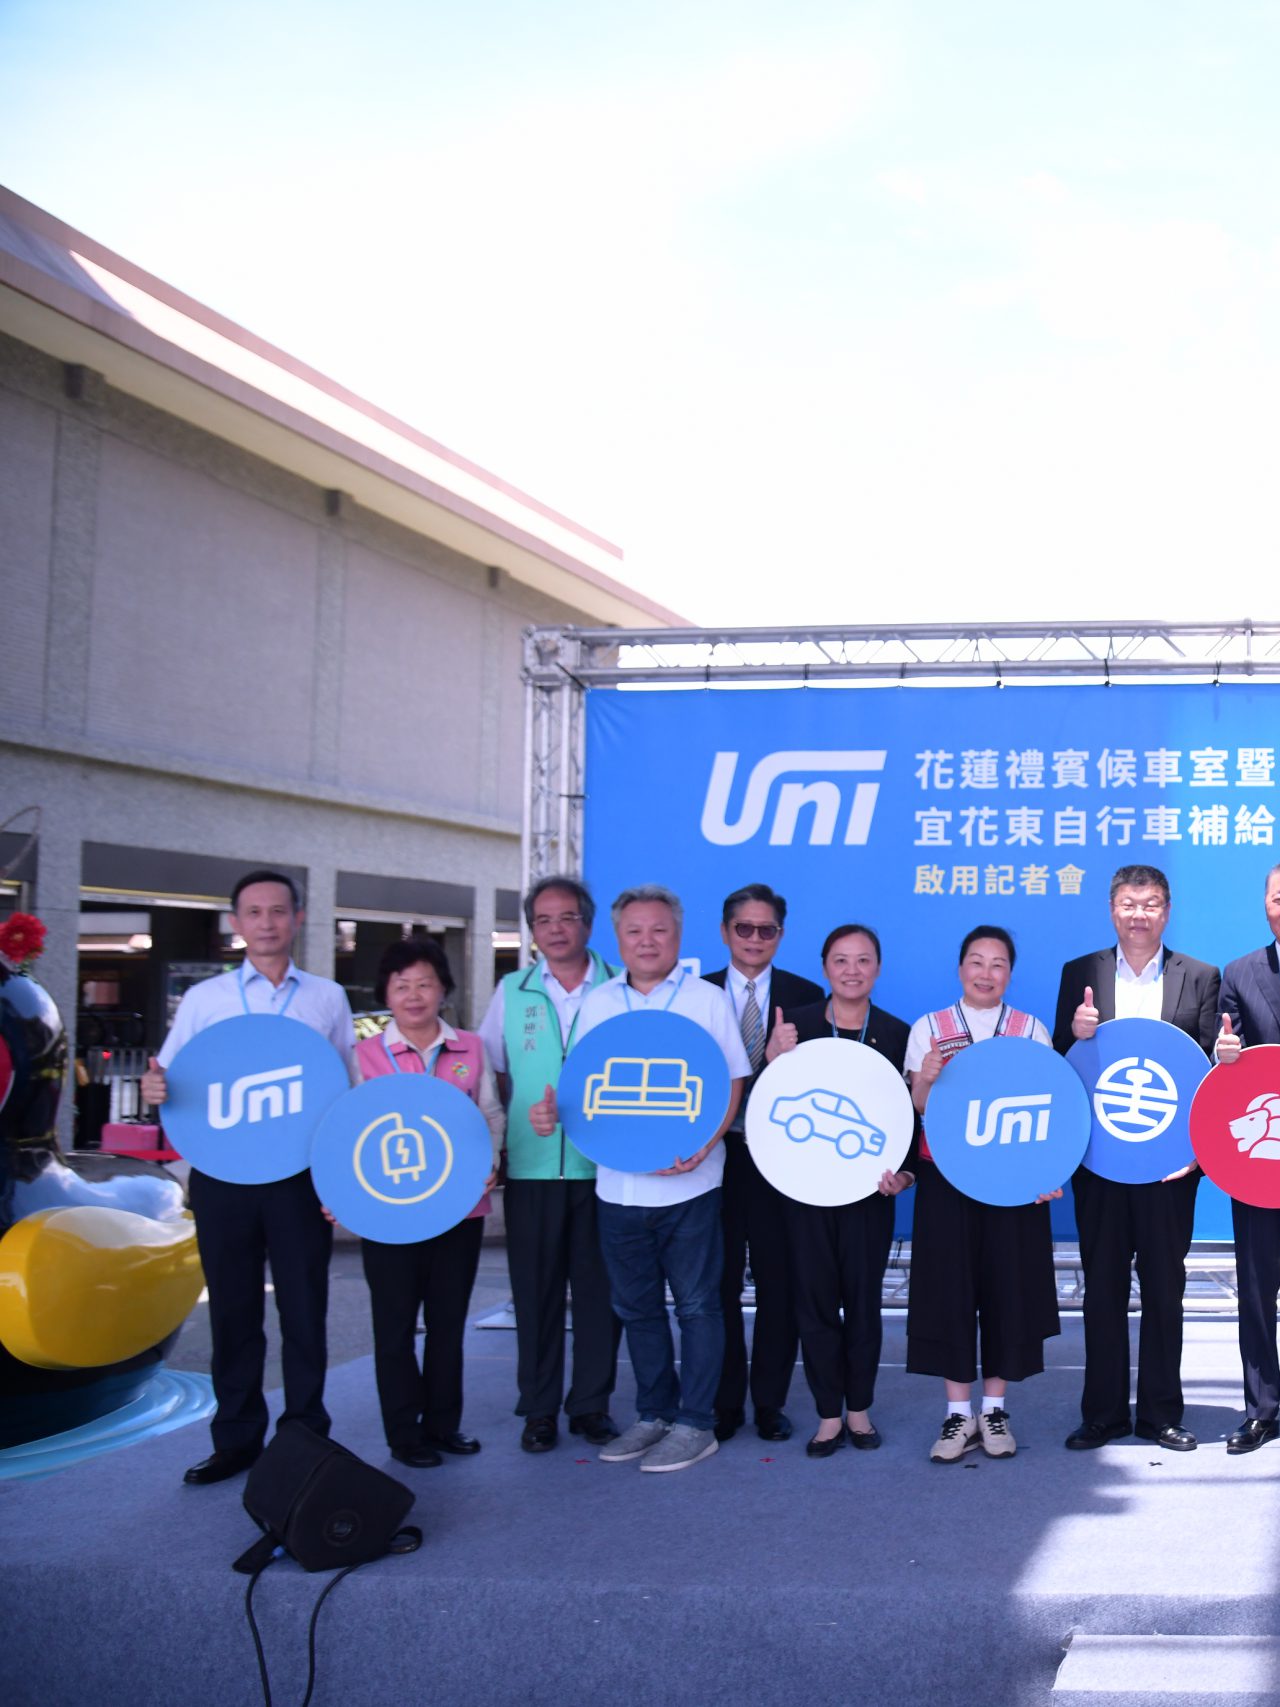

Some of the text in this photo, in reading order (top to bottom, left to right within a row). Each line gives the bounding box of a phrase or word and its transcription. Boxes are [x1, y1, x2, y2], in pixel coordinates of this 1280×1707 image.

[914, 747, 1277, 790] 花蓮禮賓候車室暨
[914, 864, 1085, 896] 啟用記者會
